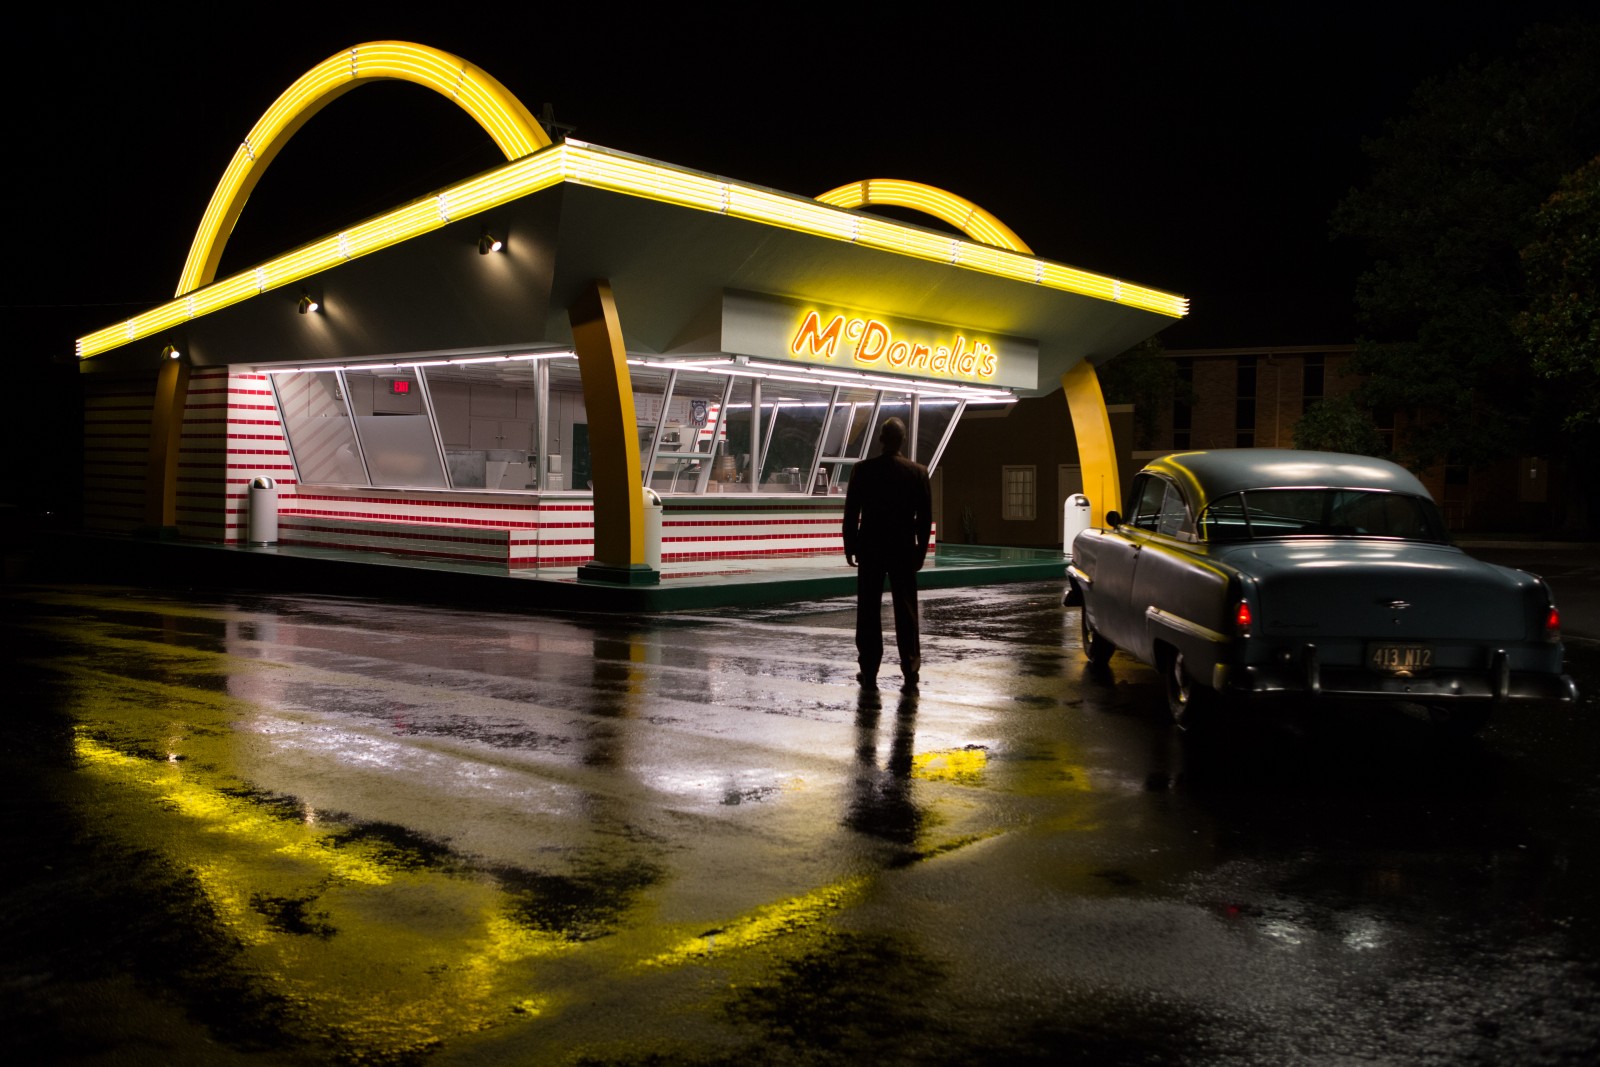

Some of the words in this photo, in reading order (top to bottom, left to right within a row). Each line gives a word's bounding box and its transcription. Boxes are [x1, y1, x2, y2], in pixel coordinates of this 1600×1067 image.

[791, 310, 998, 377] McDonald's
[393, 381, 409, 393] EXIT
[1373, 648, 1399, 666] 413
